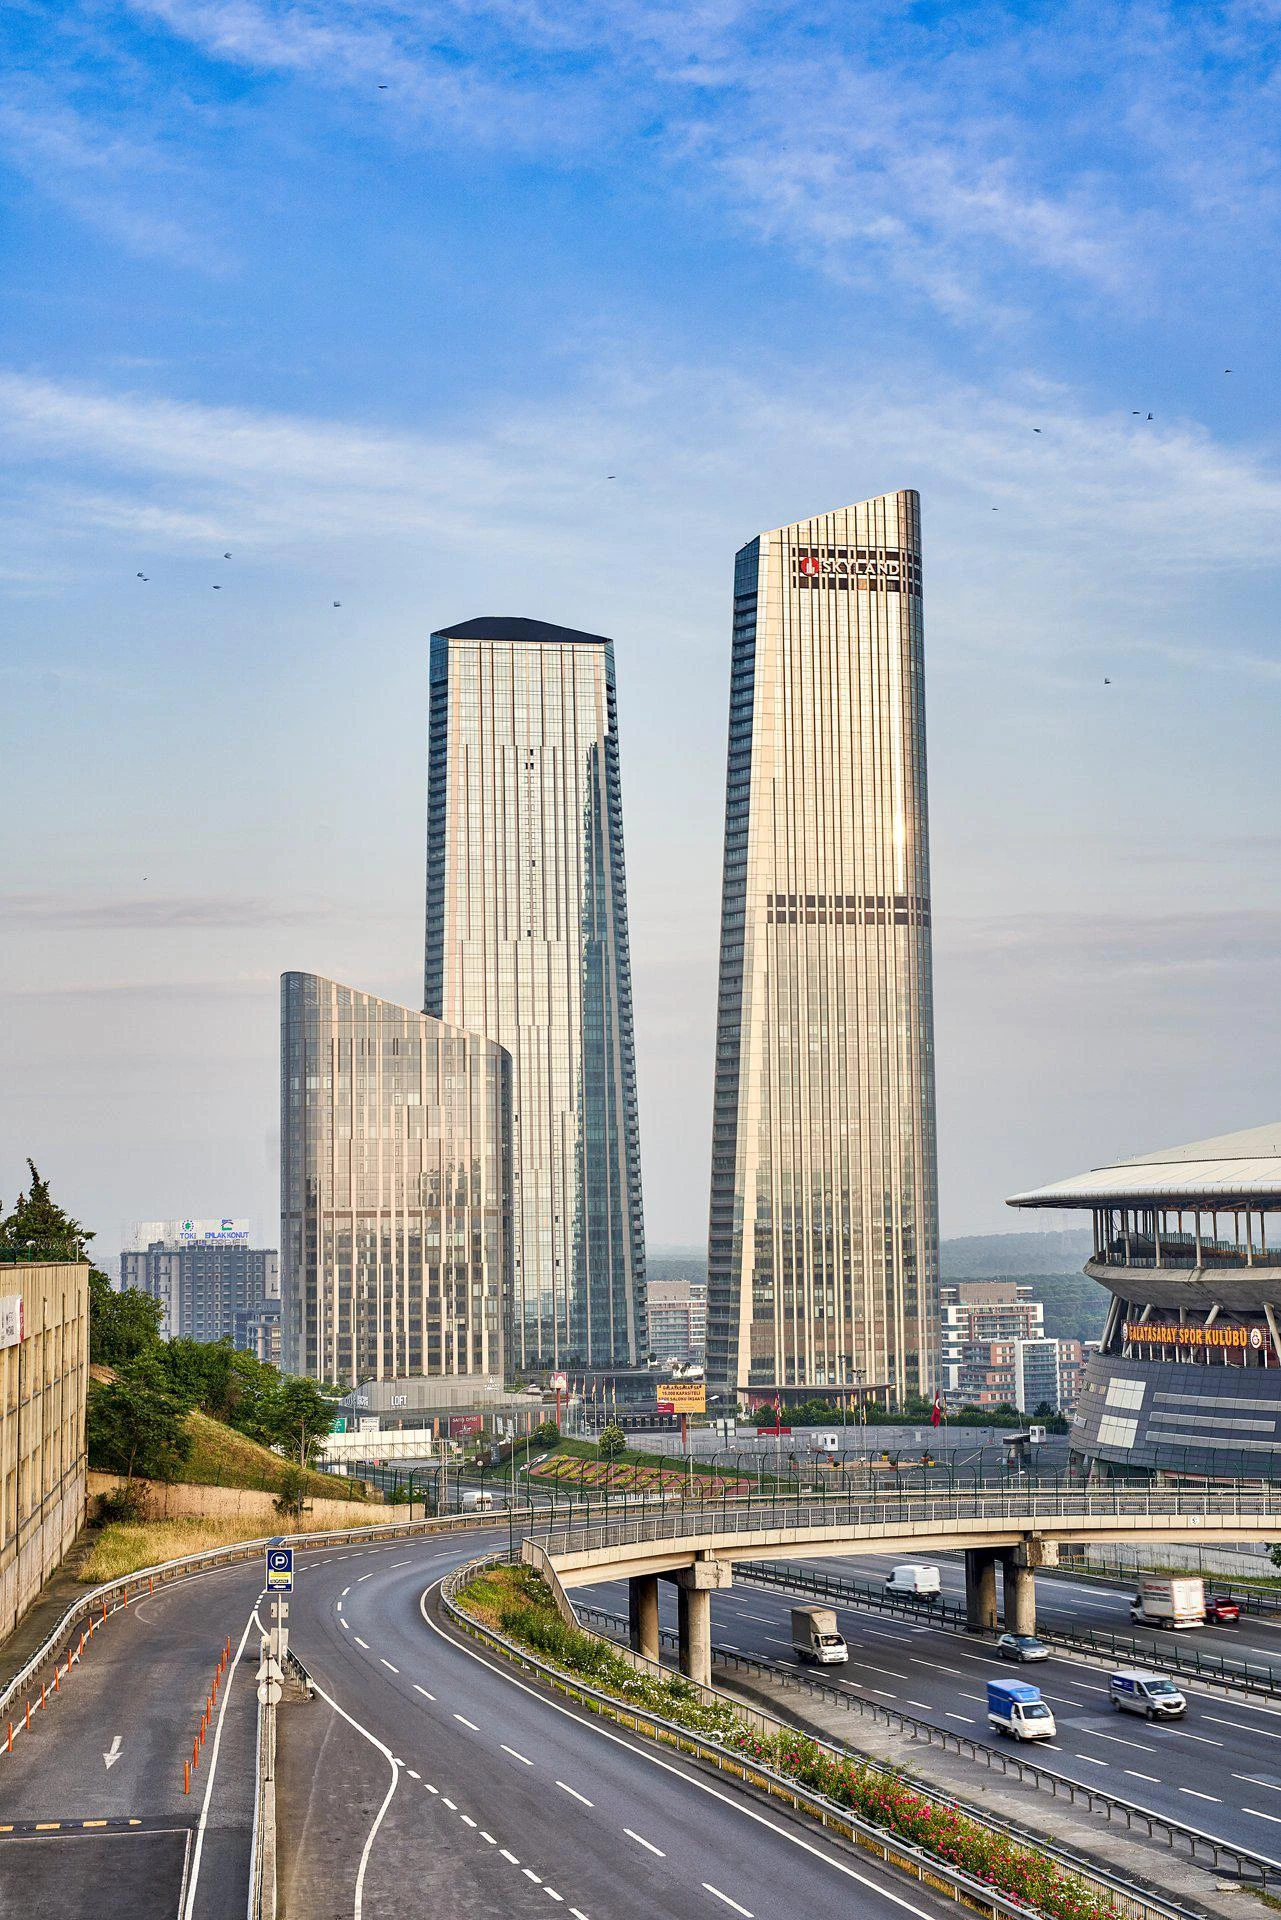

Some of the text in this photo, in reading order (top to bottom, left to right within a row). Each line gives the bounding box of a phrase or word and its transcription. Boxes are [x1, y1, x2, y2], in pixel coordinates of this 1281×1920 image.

[823, 560, 900, 575] SKYLAND
[226, 1231, 249, 1239] KONUT
[1129, 1325, 1247, 1346] GALATASARAY SPOR KULÜBÜ
[391, 1395, 408, 1405] LOFT
